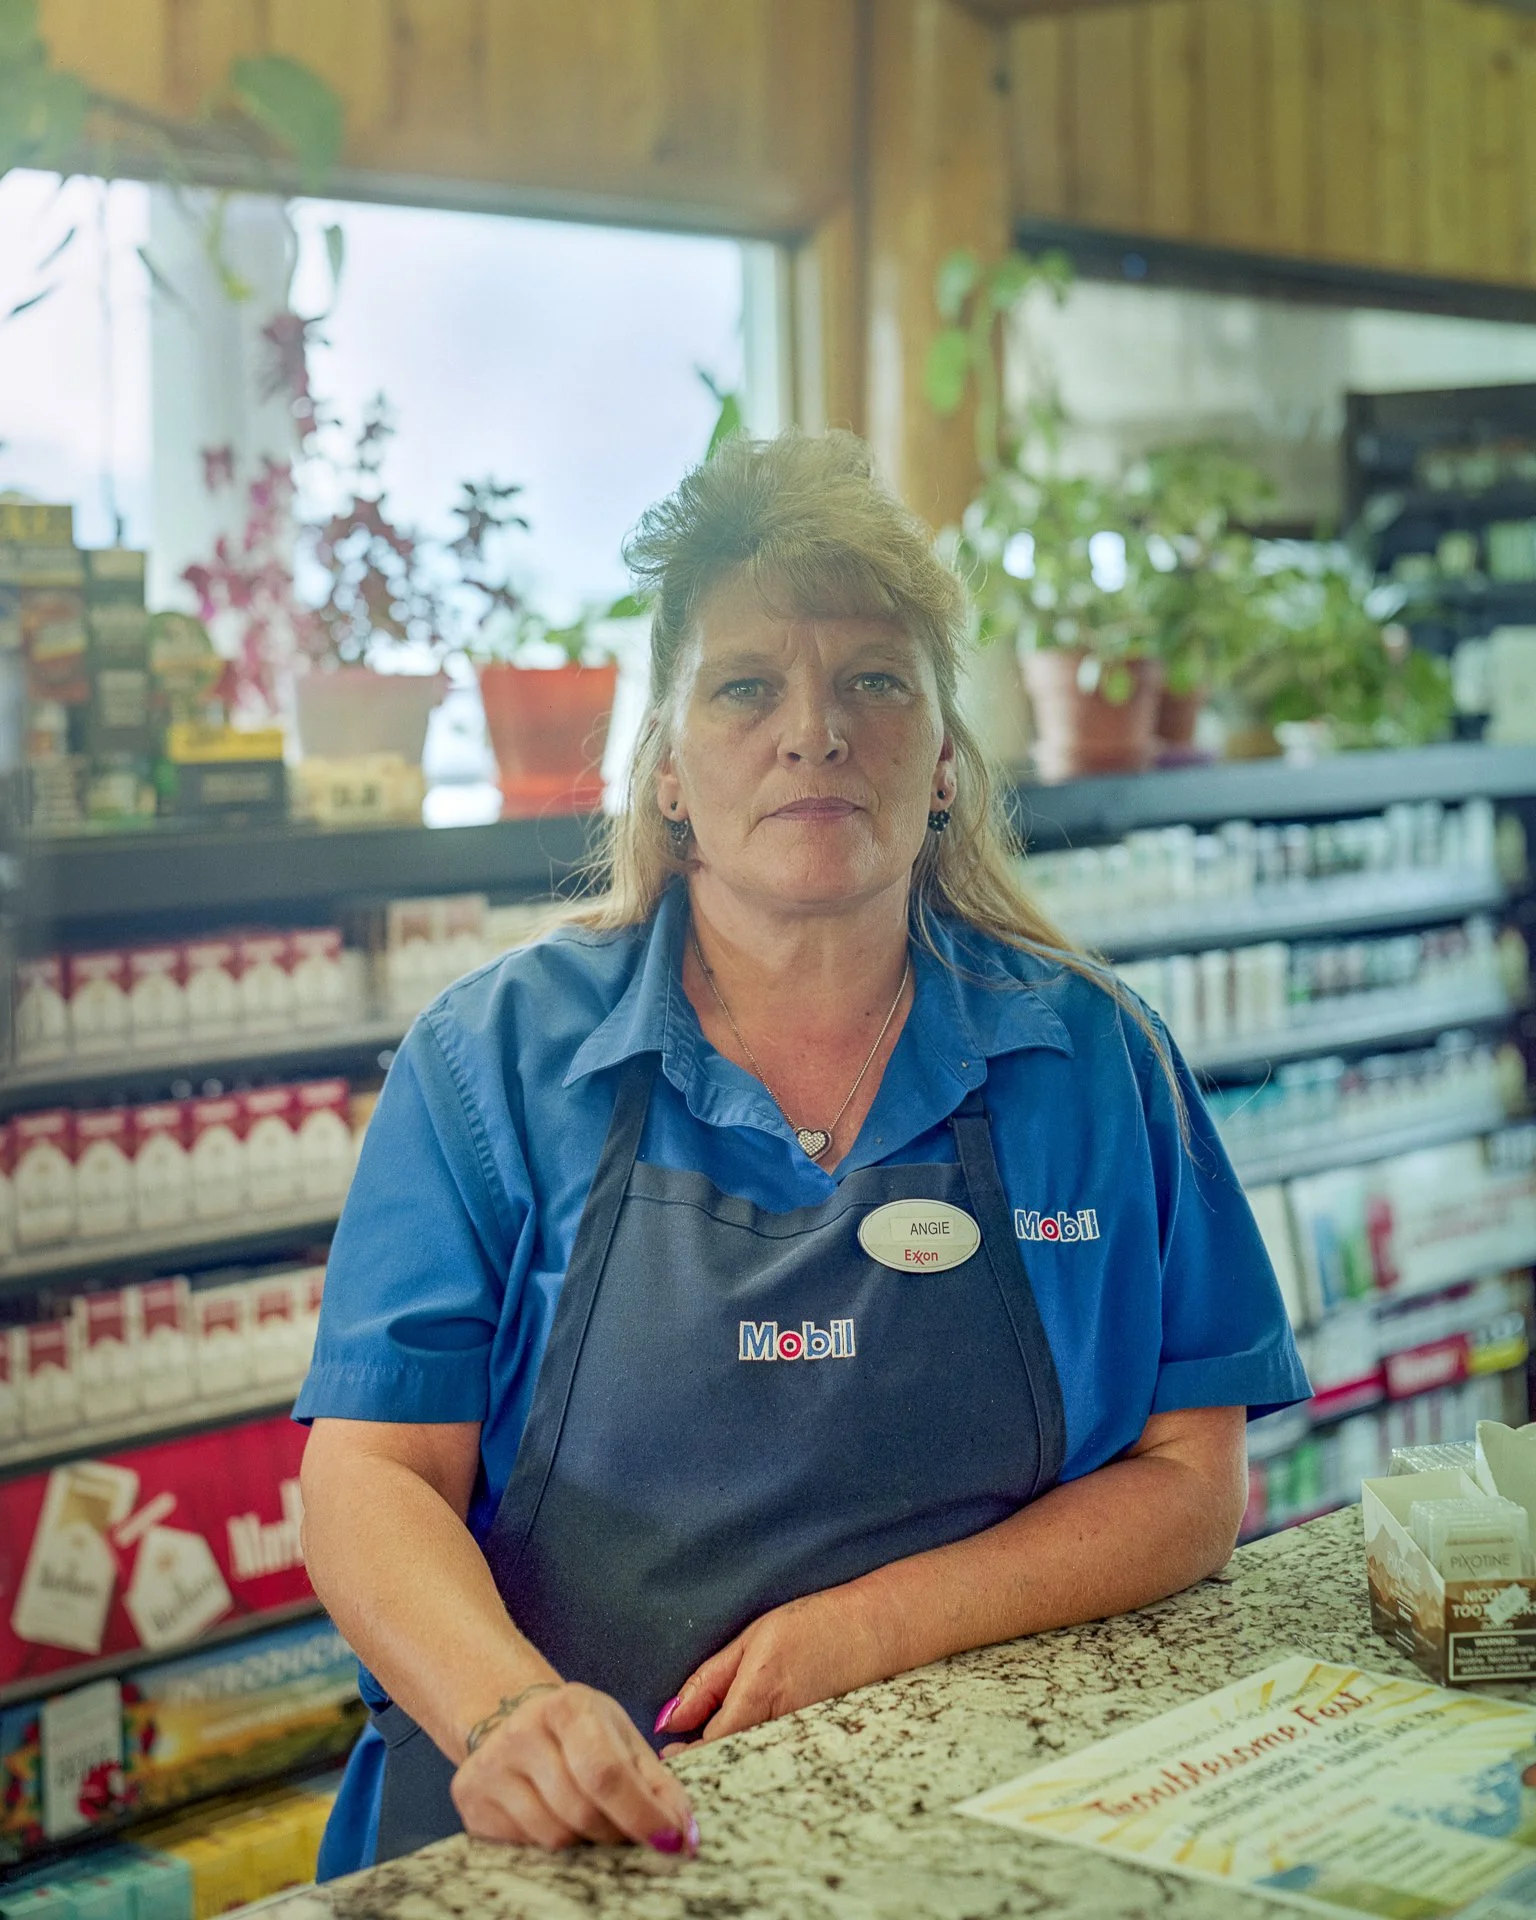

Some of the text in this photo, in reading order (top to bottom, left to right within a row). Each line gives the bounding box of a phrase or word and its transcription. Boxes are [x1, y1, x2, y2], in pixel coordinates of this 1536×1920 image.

[910, 1221, 951, 1236] ANGIE
[1014, 1208, 1100, 1242] Mobil
[904, 1248, 938, 1265] Exxon
[738, 1318, 856, 1361] Mobil
